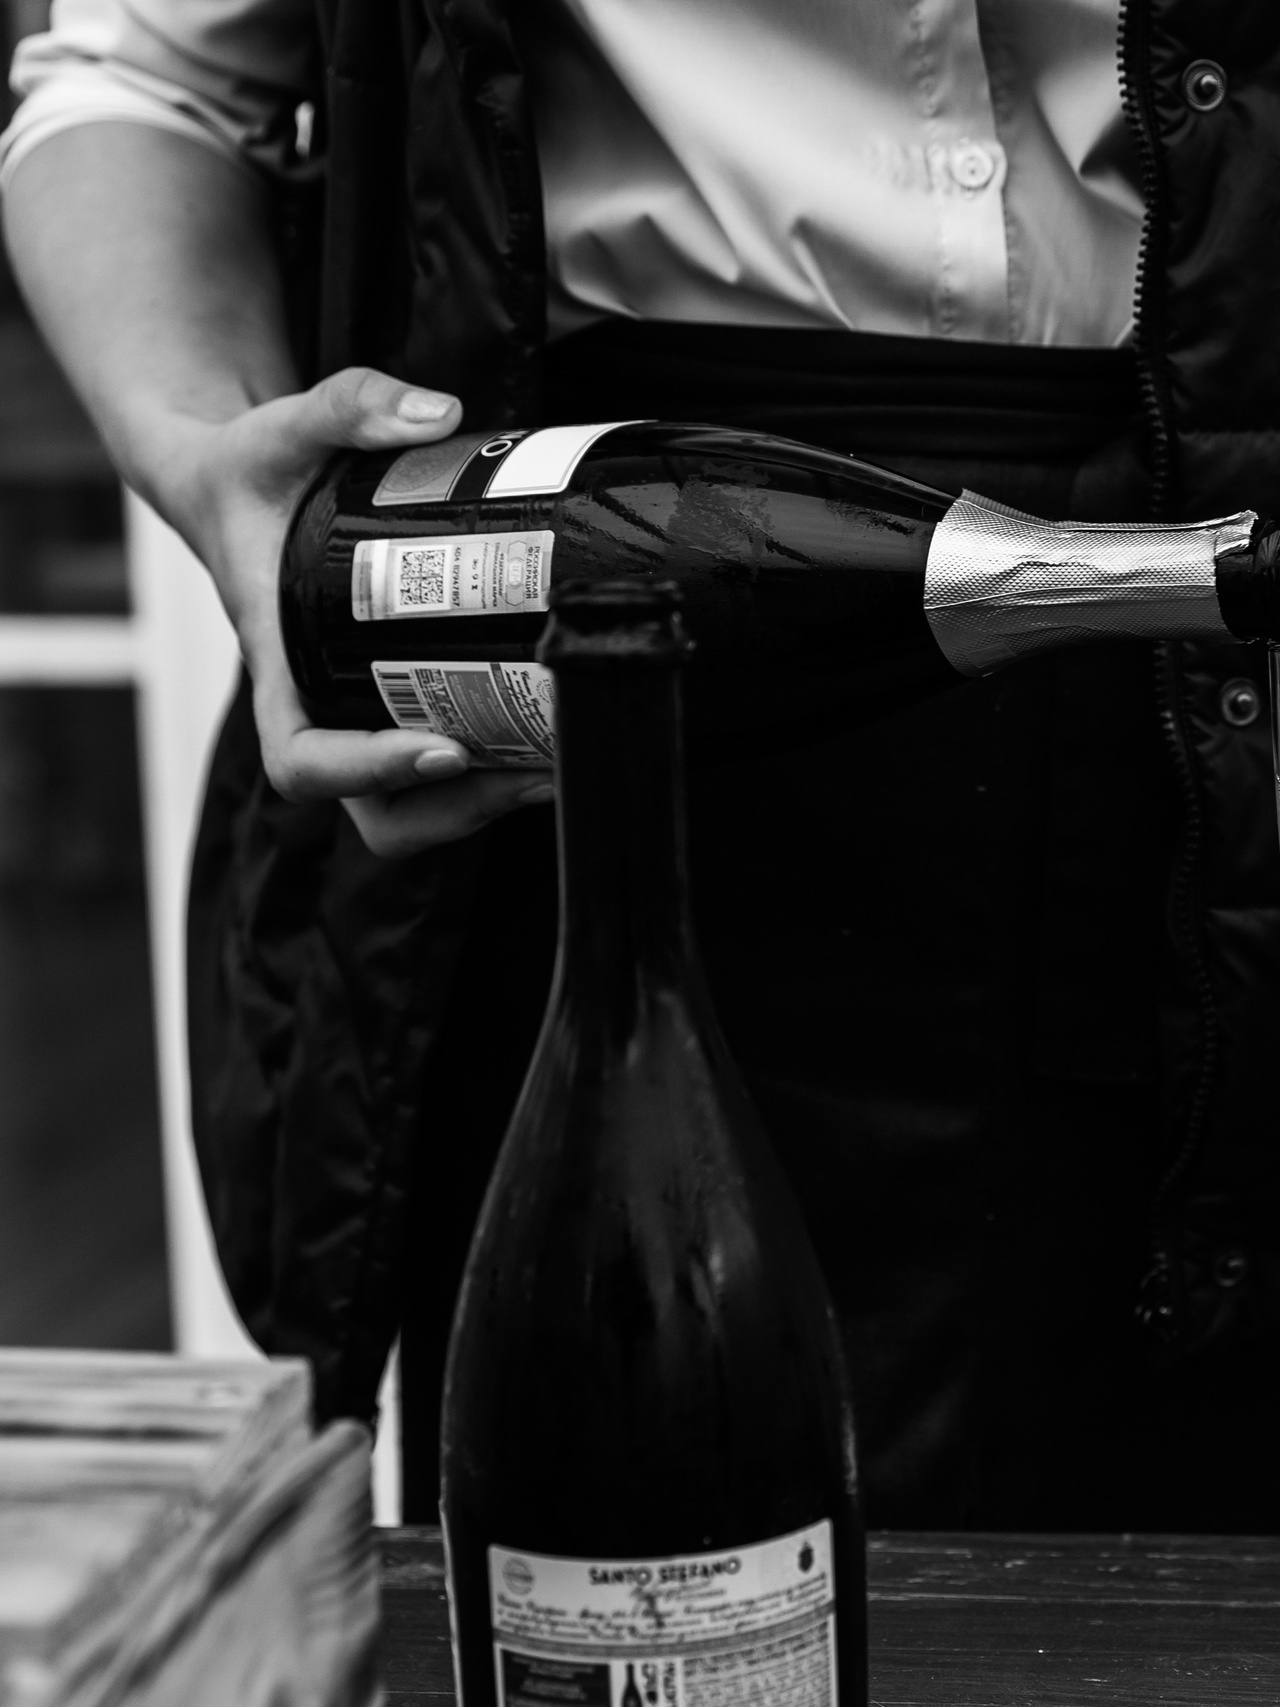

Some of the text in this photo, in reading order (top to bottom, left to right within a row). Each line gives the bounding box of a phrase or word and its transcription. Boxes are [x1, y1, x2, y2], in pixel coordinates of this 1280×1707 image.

[525, 546, 534, 599] ФЕДЕРАЦИЯ
[532, 545, 541, 599] РОССИЙСКАЯ
[588, 1556, 742, 1585] SANTO STEFANO
